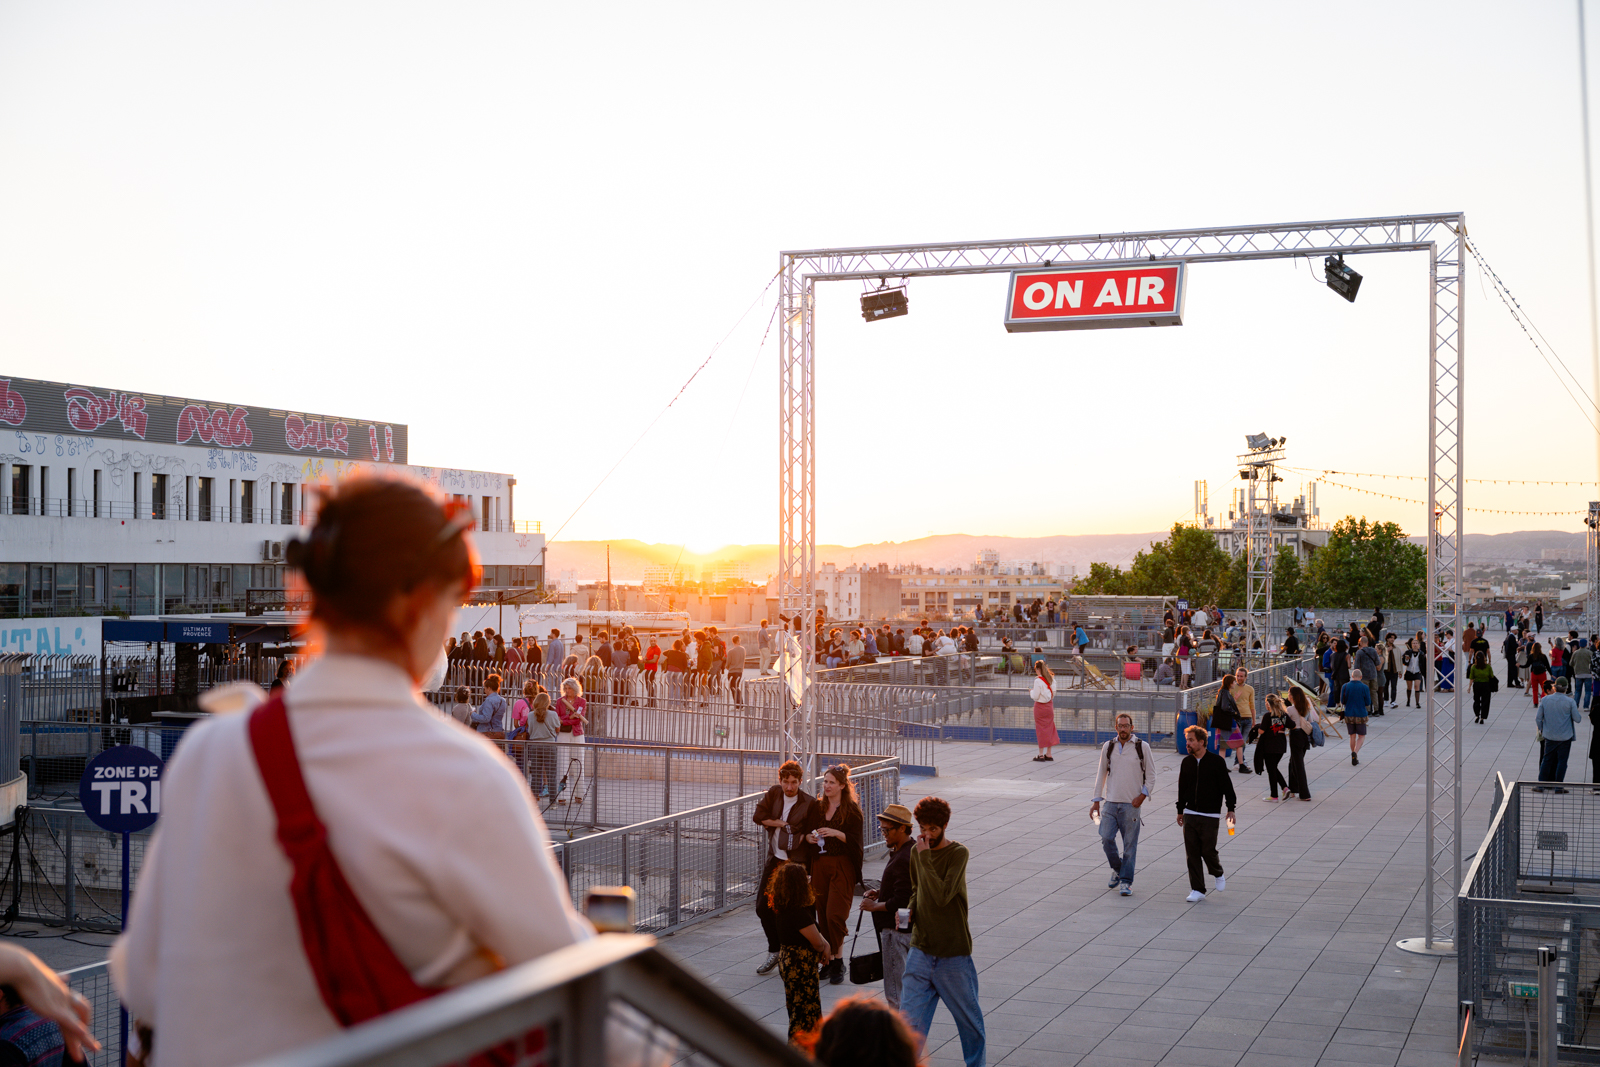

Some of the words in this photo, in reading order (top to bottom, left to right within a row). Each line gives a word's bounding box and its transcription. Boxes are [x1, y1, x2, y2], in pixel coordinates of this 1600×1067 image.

[1023, 280, 1084, 311] ON
[1093, 276, 1165, 308] AIR
[94, 766, 136, 779] ZONE
[139, 766, 158, 778] DE
[91, 780, 160, 815] TRI
